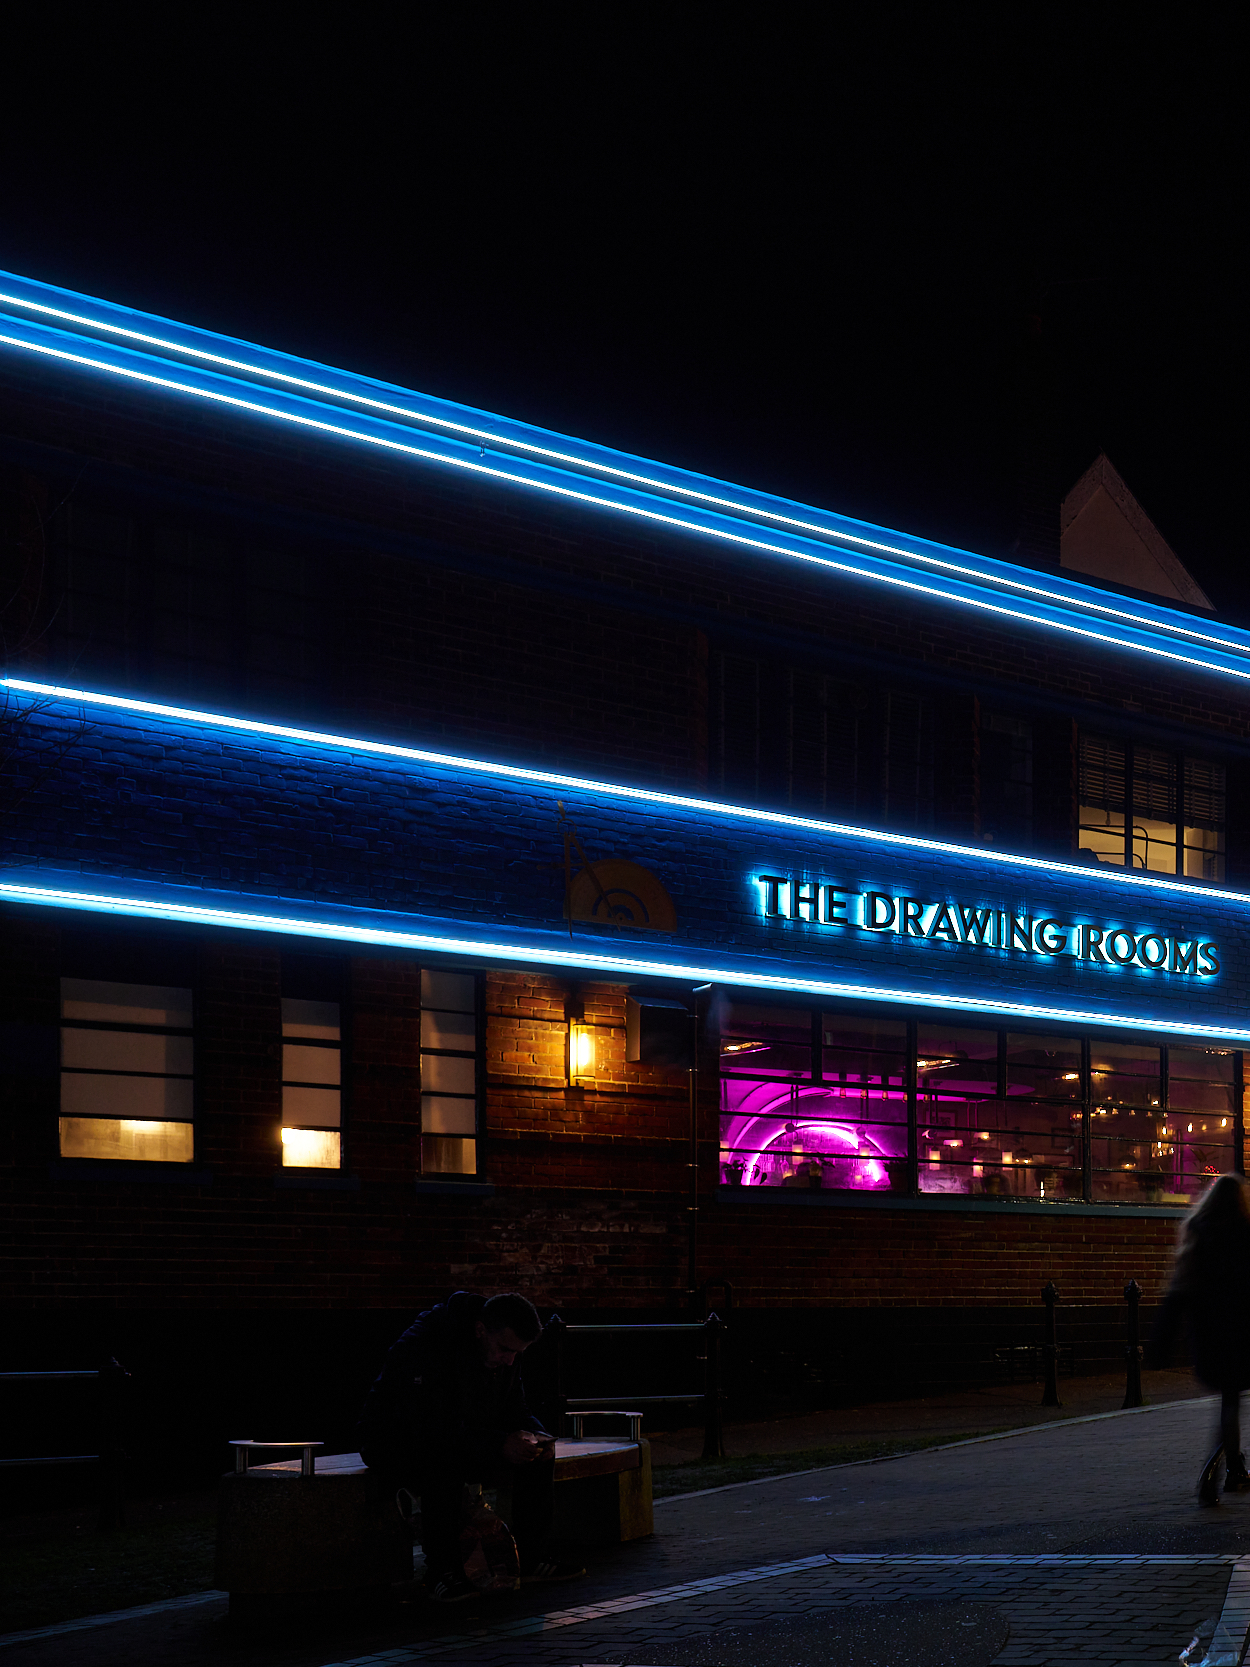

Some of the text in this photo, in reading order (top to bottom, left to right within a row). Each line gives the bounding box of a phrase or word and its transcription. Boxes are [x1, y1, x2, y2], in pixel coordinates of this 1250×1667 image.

[758, 875, 1222, 977] THE DRAWING ROOMS
